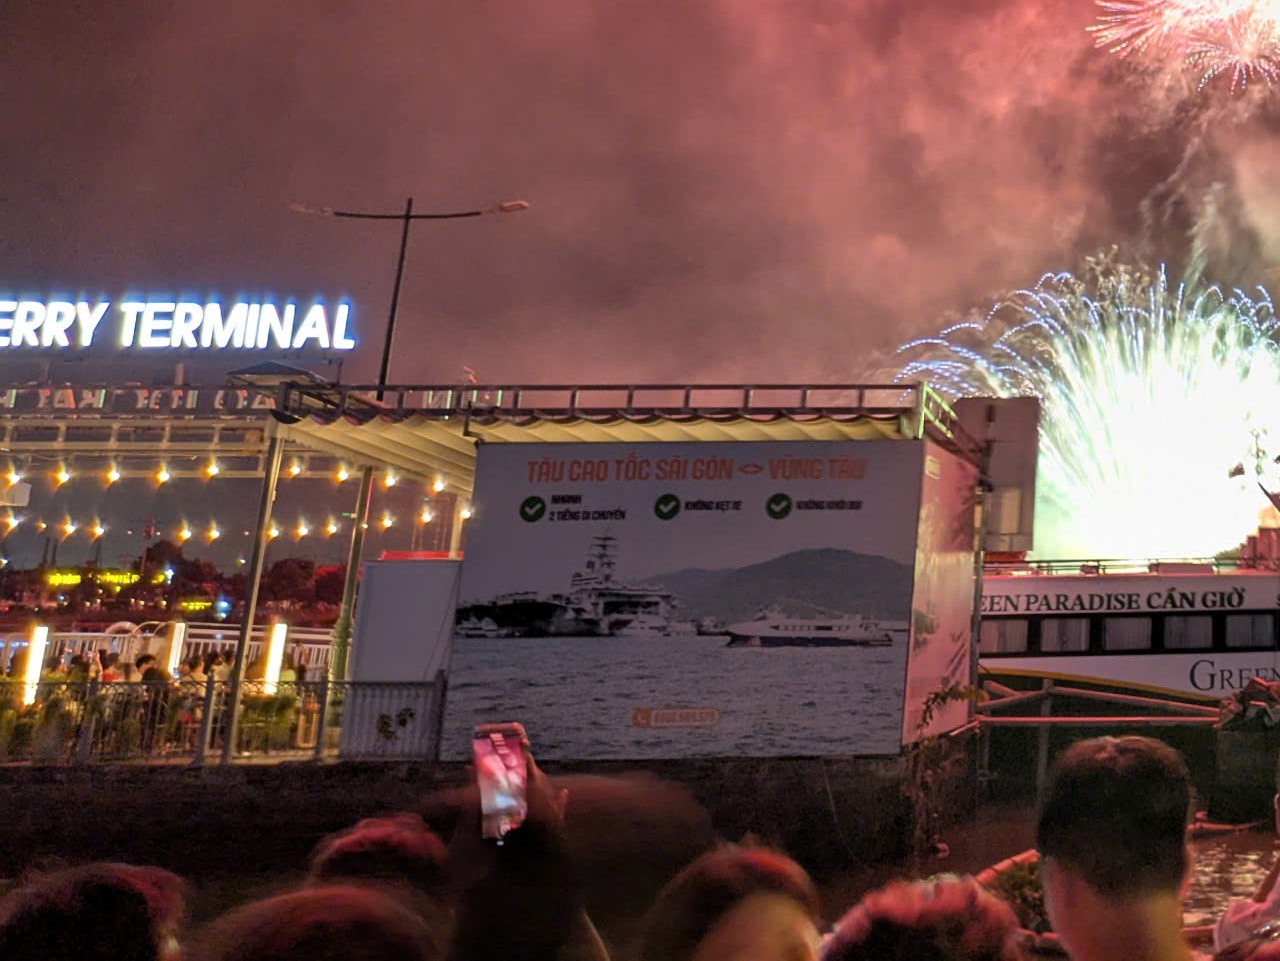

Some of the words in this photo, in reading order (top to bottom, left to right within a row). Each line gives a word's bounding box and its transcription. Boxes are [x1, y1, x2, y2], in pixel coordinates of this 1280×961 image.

[120, 302, 356, 349] TERMINAL
[568, 459, 609, 482] CAO
[1025, 592, 1141, 612] PARADISE
